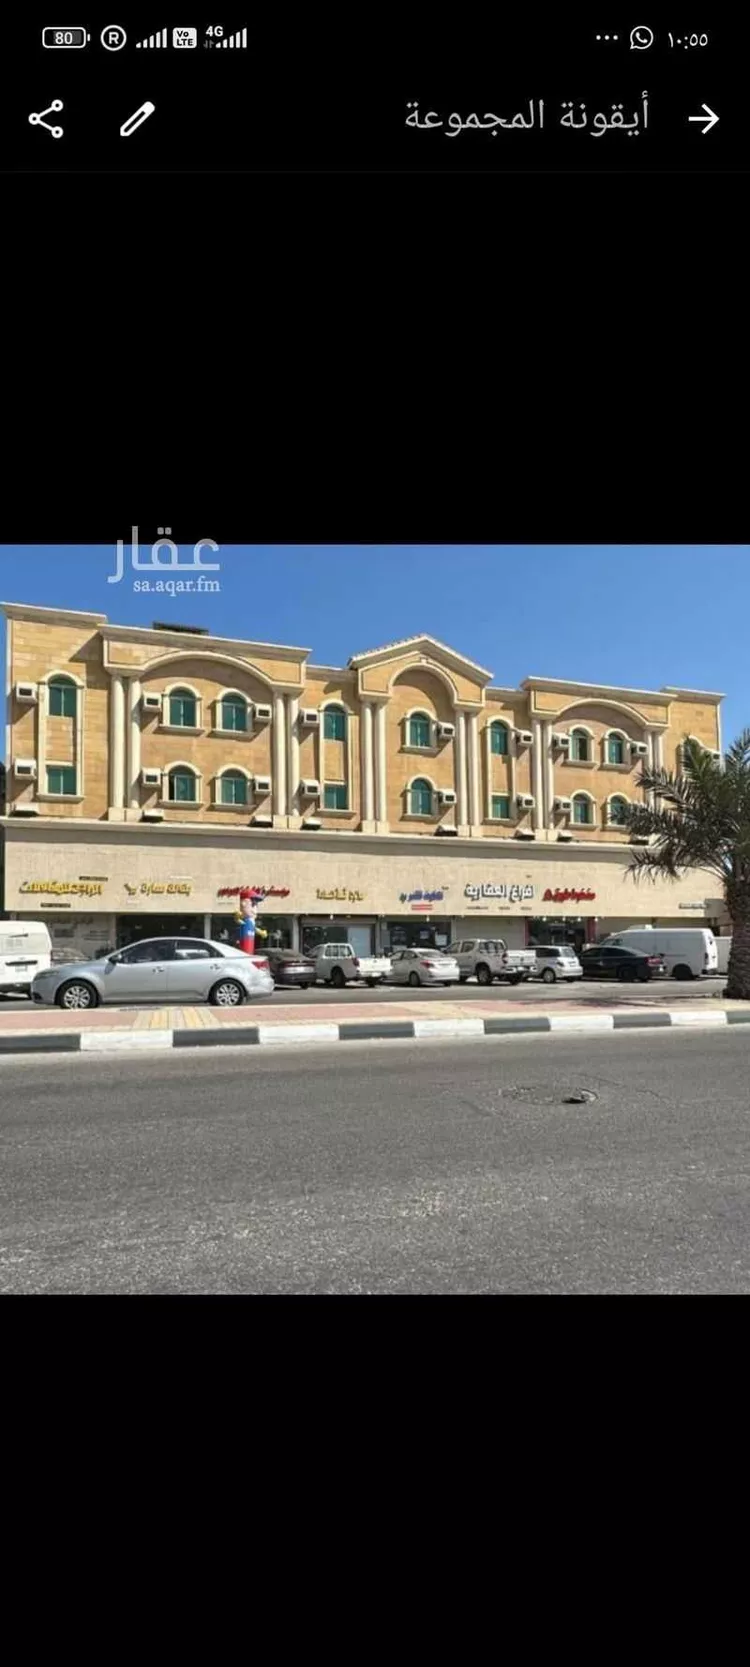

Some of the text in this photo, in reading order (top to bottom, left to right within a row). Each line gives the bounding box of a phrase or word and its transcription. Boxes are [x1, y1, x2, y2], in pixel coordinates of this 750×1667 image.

[55, 31, 73, 45] 80
[176, 30, 190, 38] Vo
[205, 26, 224, 37] 4G
[176, 38, 194, 47] LTE
[667, 31, 709, 49] ١٠:٥٥
[404, 90, 650, 138] أيقونة المجموعة
[463, 882, 508, 902] العقارية
